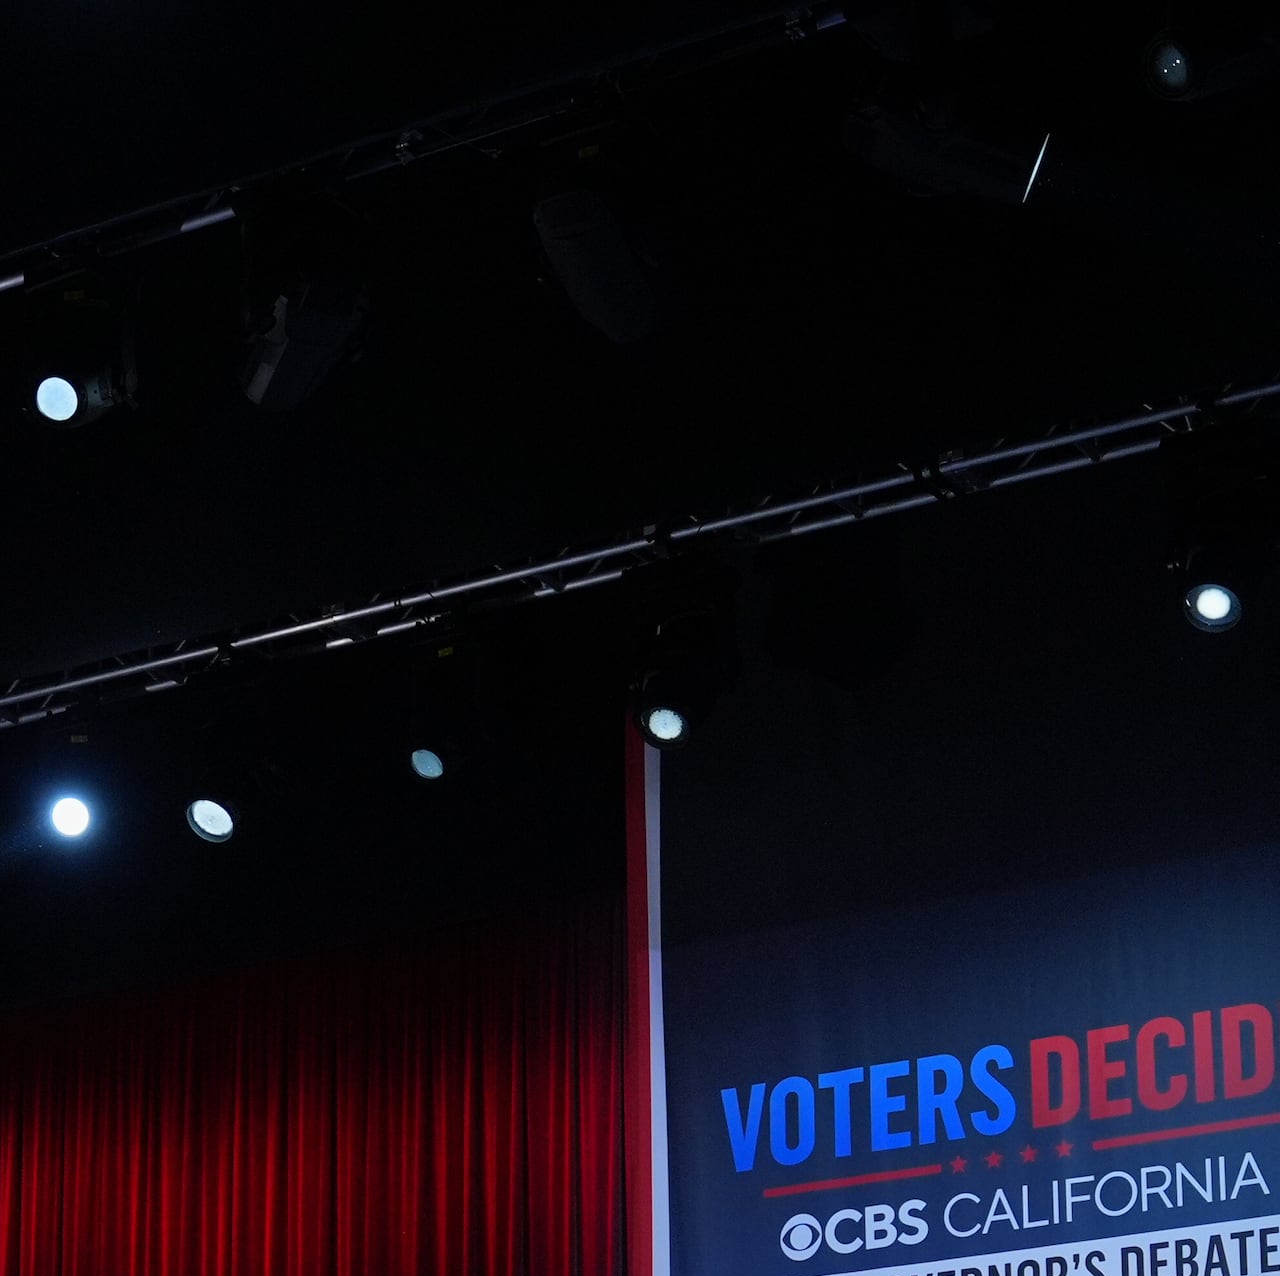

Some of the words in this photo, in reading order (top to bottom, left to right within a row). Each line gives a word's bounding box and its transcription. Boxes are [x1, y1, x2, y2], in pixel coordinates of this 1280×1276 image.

[721, 1043, 1019, 1173] VOTERS
[824, 1199, 930, 1255] CBS
[943, 1152, 1270, 1239] CALIFORNIA
